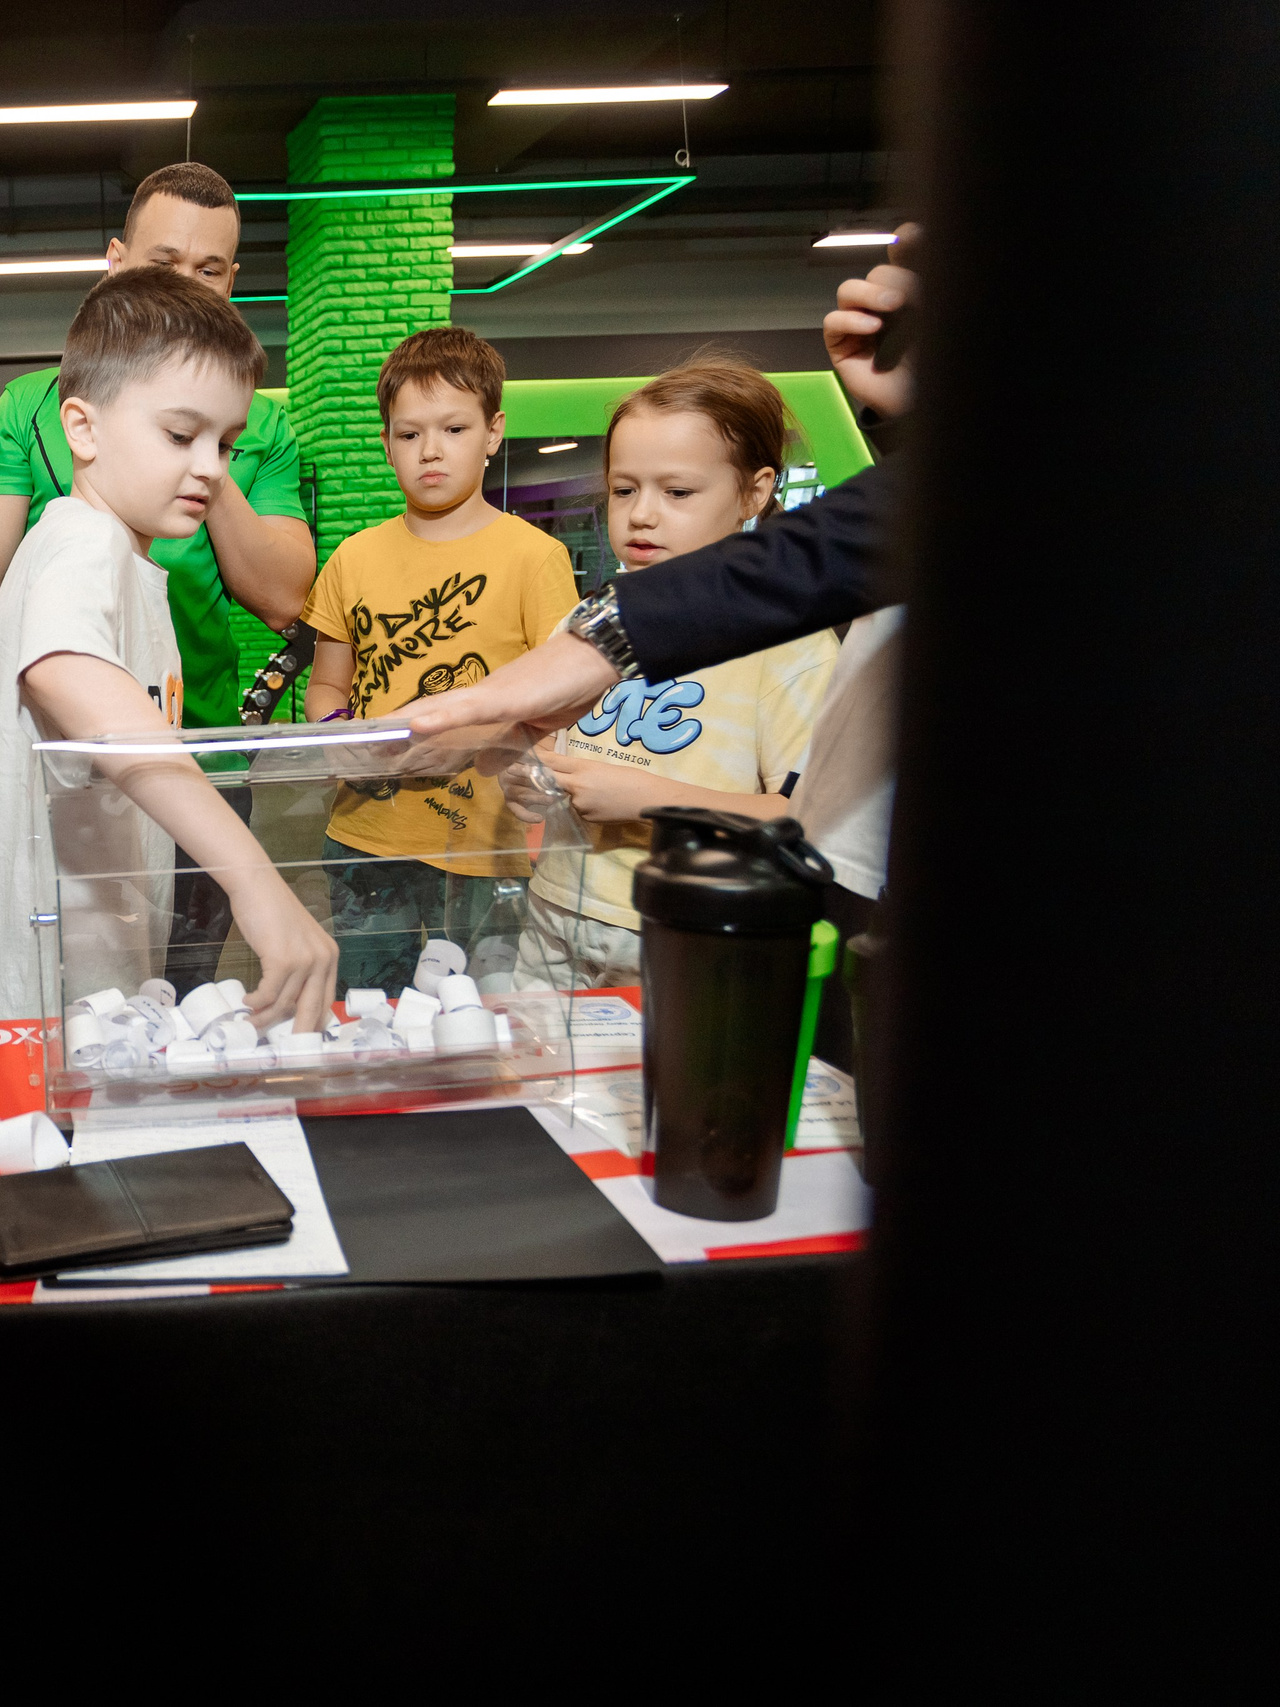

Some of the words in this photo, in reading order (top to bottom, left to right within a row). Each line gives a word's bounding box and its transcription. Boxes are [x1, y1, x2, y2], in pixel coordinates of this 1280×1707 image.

[567, 677, 706, 755] UTE
[568, 738, 603, 754] FUTURINO
[606, 748, 652, 767] FASHION
